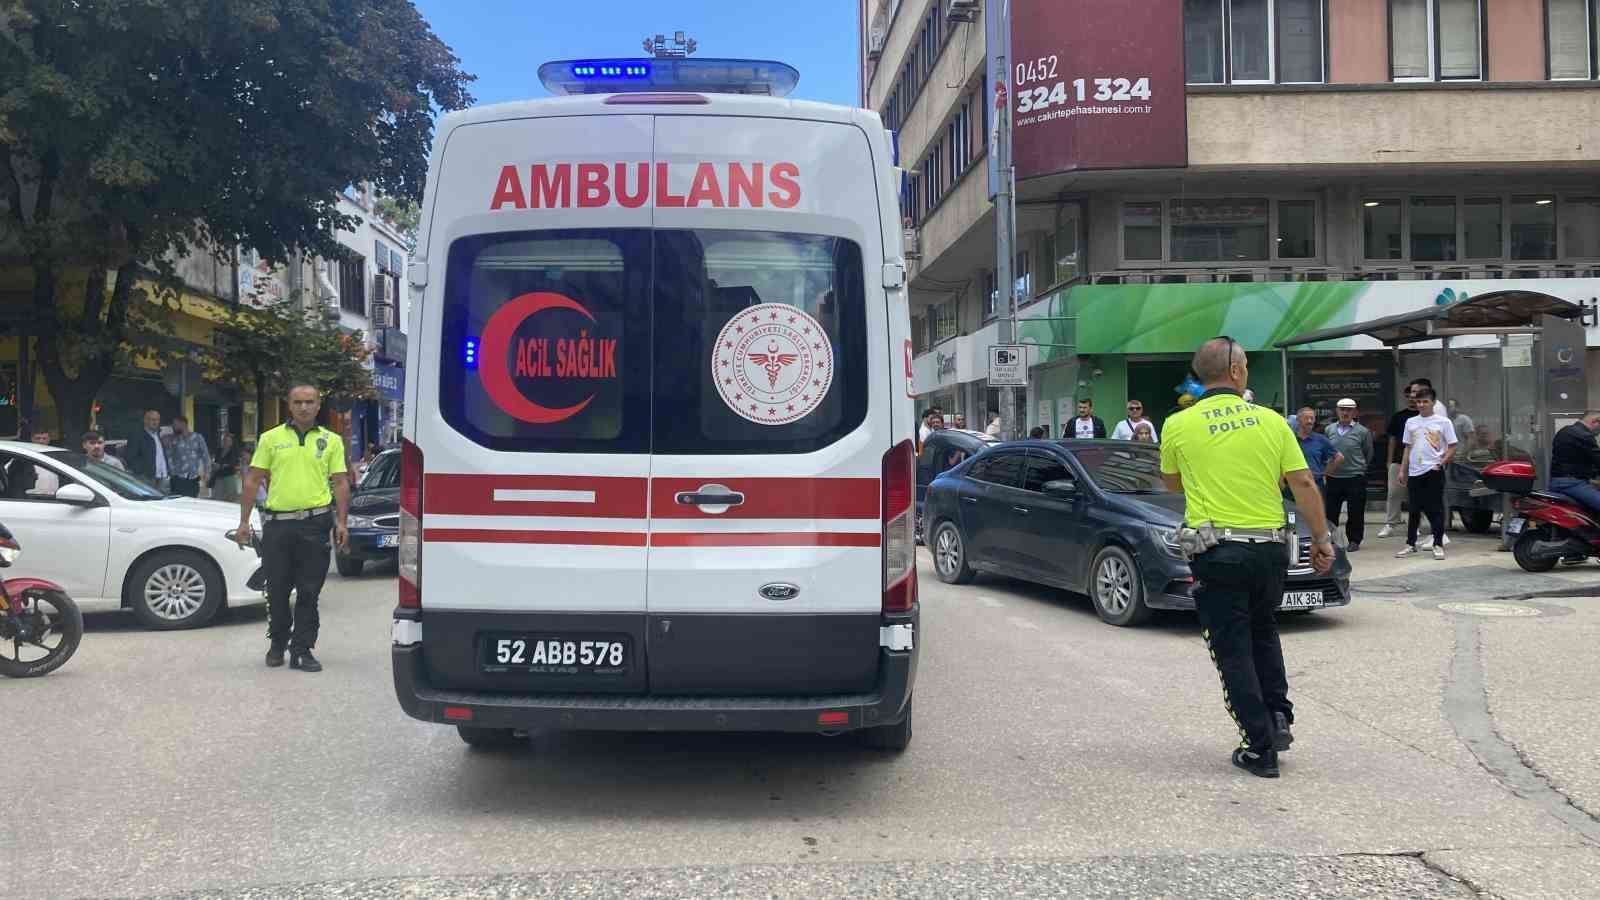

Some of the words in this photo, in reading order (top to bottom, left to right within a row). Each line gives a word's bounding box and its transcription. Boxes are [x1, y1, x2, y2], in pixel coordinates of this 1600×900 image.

[1016, 55, 1058, 86] 0452
[1017, 81, 1068, 113] 324
[1073, 78, 1086, 102] 1
[1093, 77, 1152, 101] 324
[489, 162, 801, 210] AMBULANS
[515, 338, 552, 377] ACİL
[556, 328, 617, 378] SAĞLIK
[1286, 593, 1303, 606] AIK
[1305, 592, 1322, 605] 364
[497, 639, 526, 664] 52
[532, 640, 576, 665] ABB
[580, 641, 624, 666] 578
